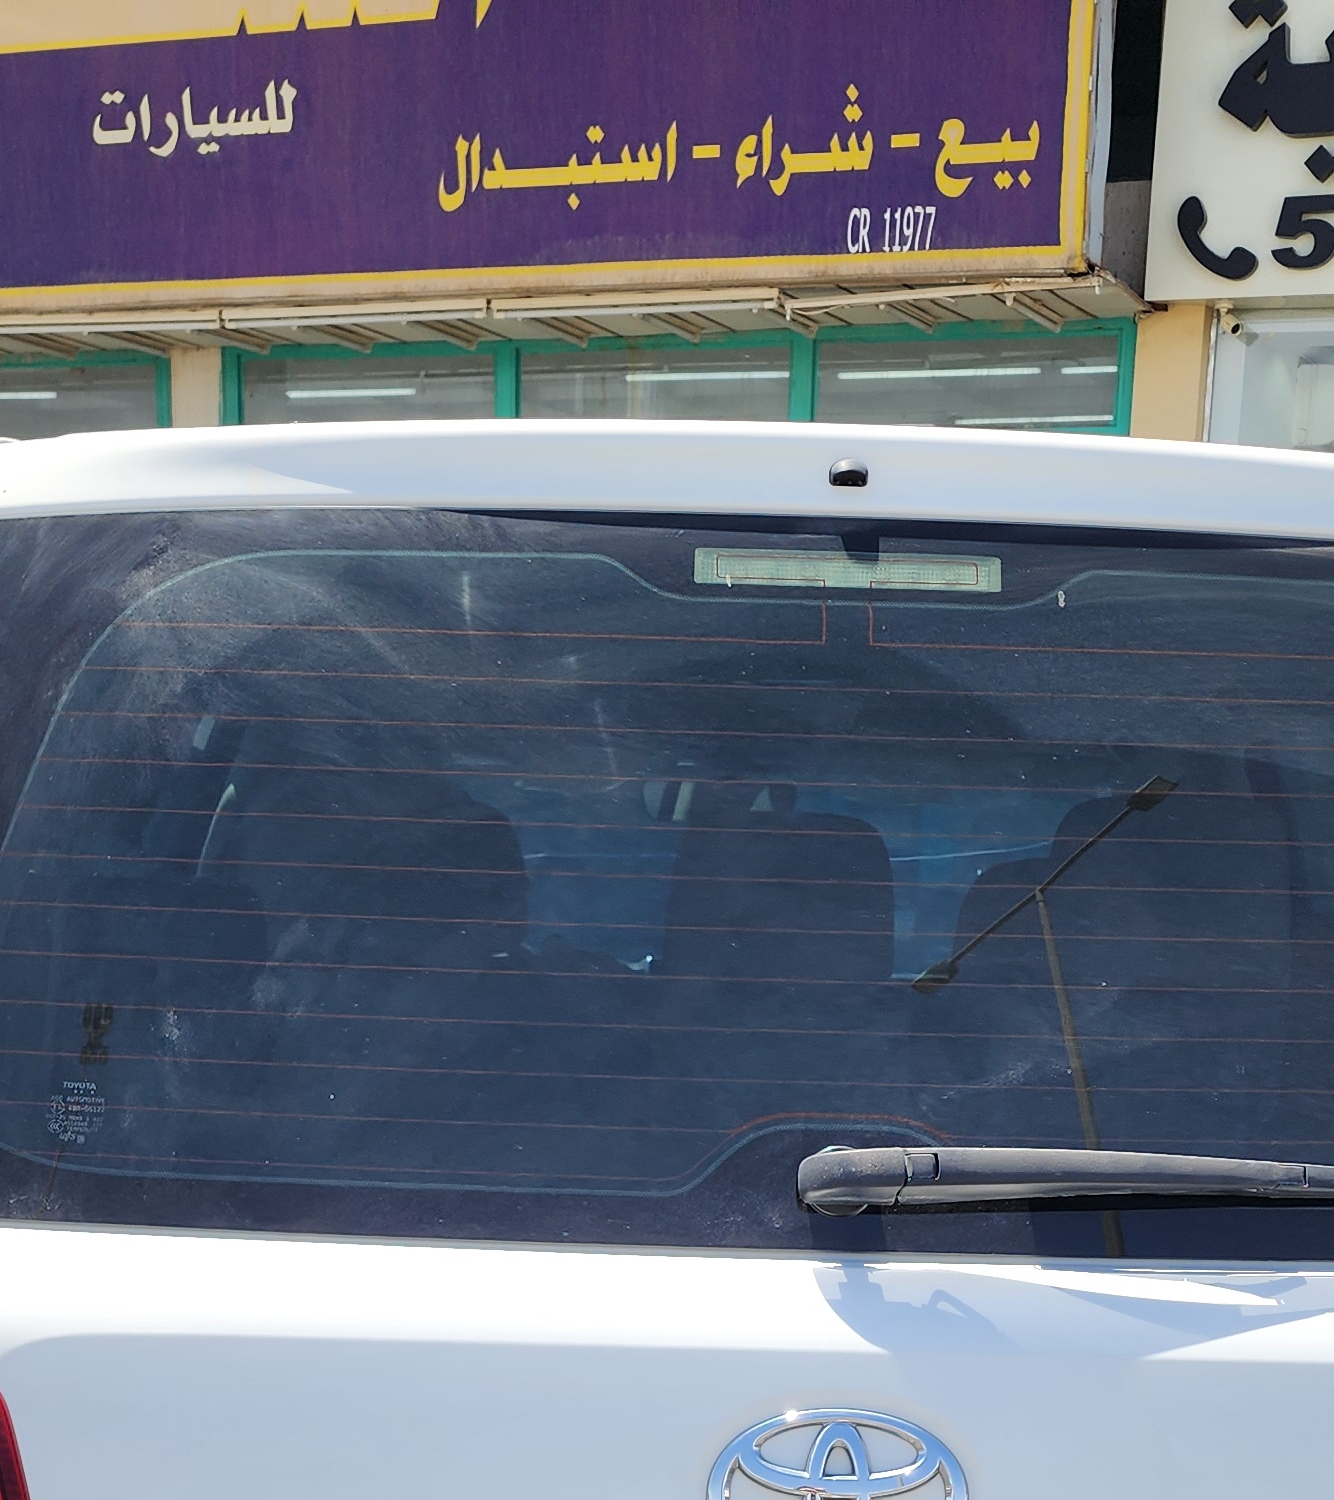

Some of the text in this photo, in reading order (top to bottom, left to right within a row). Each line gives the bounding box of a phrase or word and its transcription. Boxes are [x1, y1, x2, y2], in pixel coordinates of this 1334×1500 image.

[92, 79, 298, 158] للسيارات
[734, 83, 875, 199] شراء
[934, 117, 1040, 199] بيع
[438, 119, 677, 213] استبدال
[847, 206, 937, 254] CR 11977
[63, 1081, 97, 1090] TOYOTA
